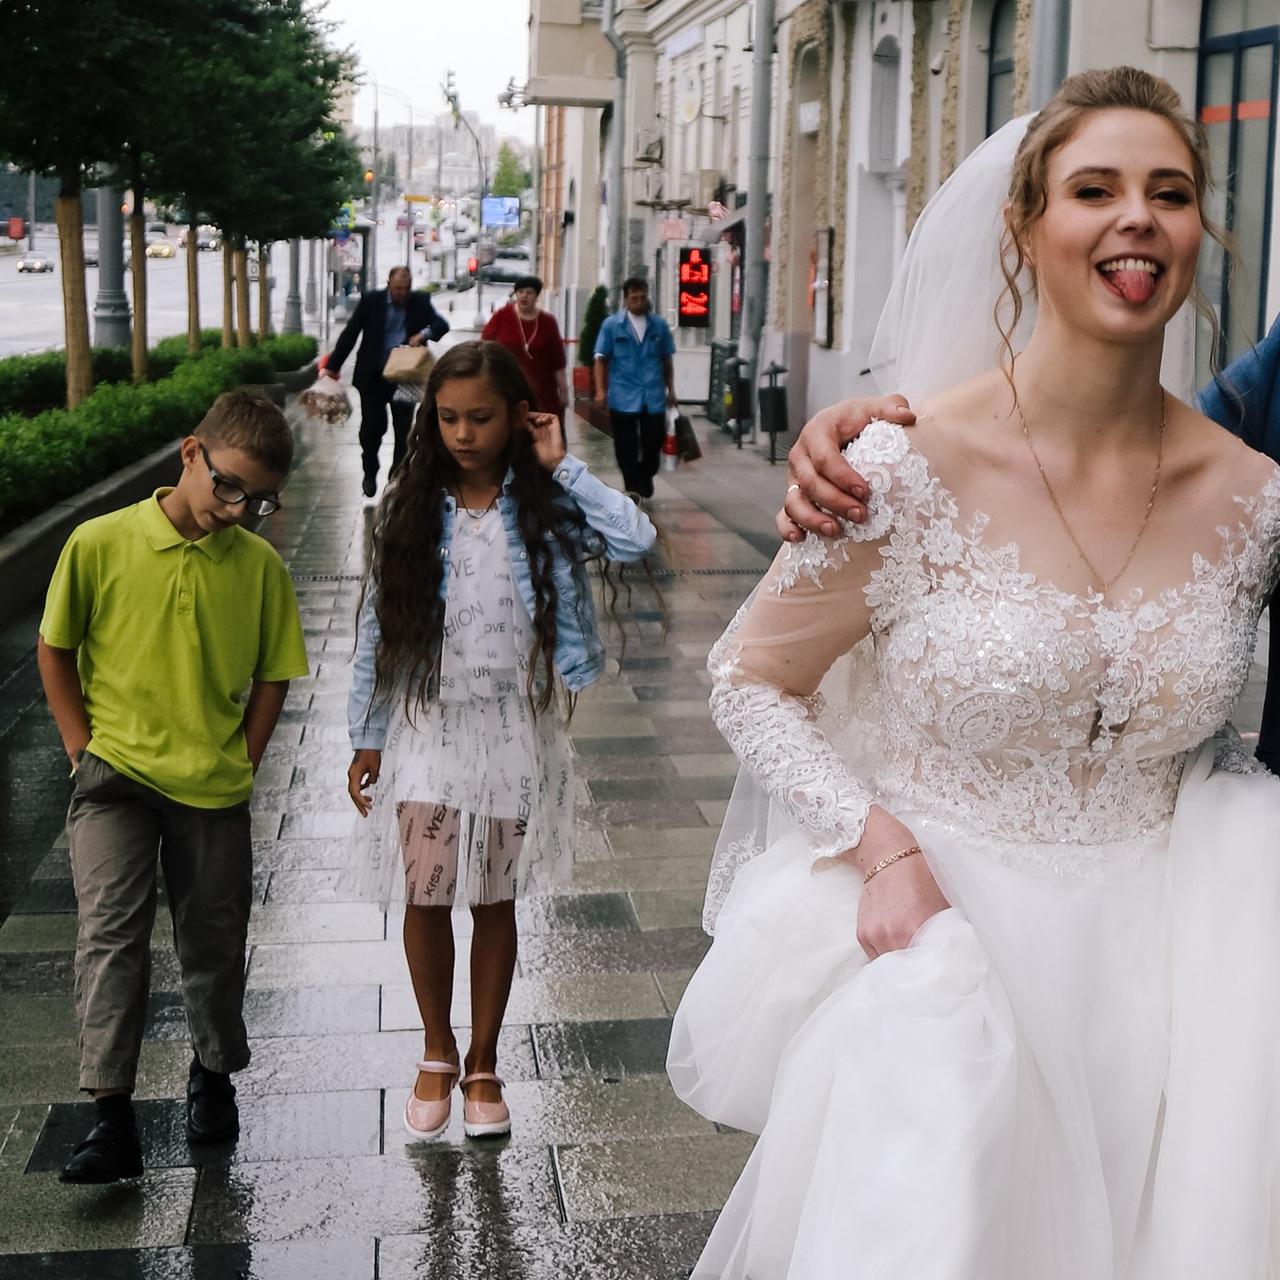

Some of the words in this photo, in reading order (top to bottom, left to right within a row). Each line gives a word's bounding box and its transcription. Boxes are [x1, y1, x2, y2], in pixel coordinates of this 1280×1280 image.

[443, 599, 485, 638] HION
[484, 622, 506, 634] OVE
[440, 675, 456, 689] SS
[422, 781, 455, 841] WEAR
[513, 775, 532, 838] WEAR
[423, 864, 444, 898] KISS
